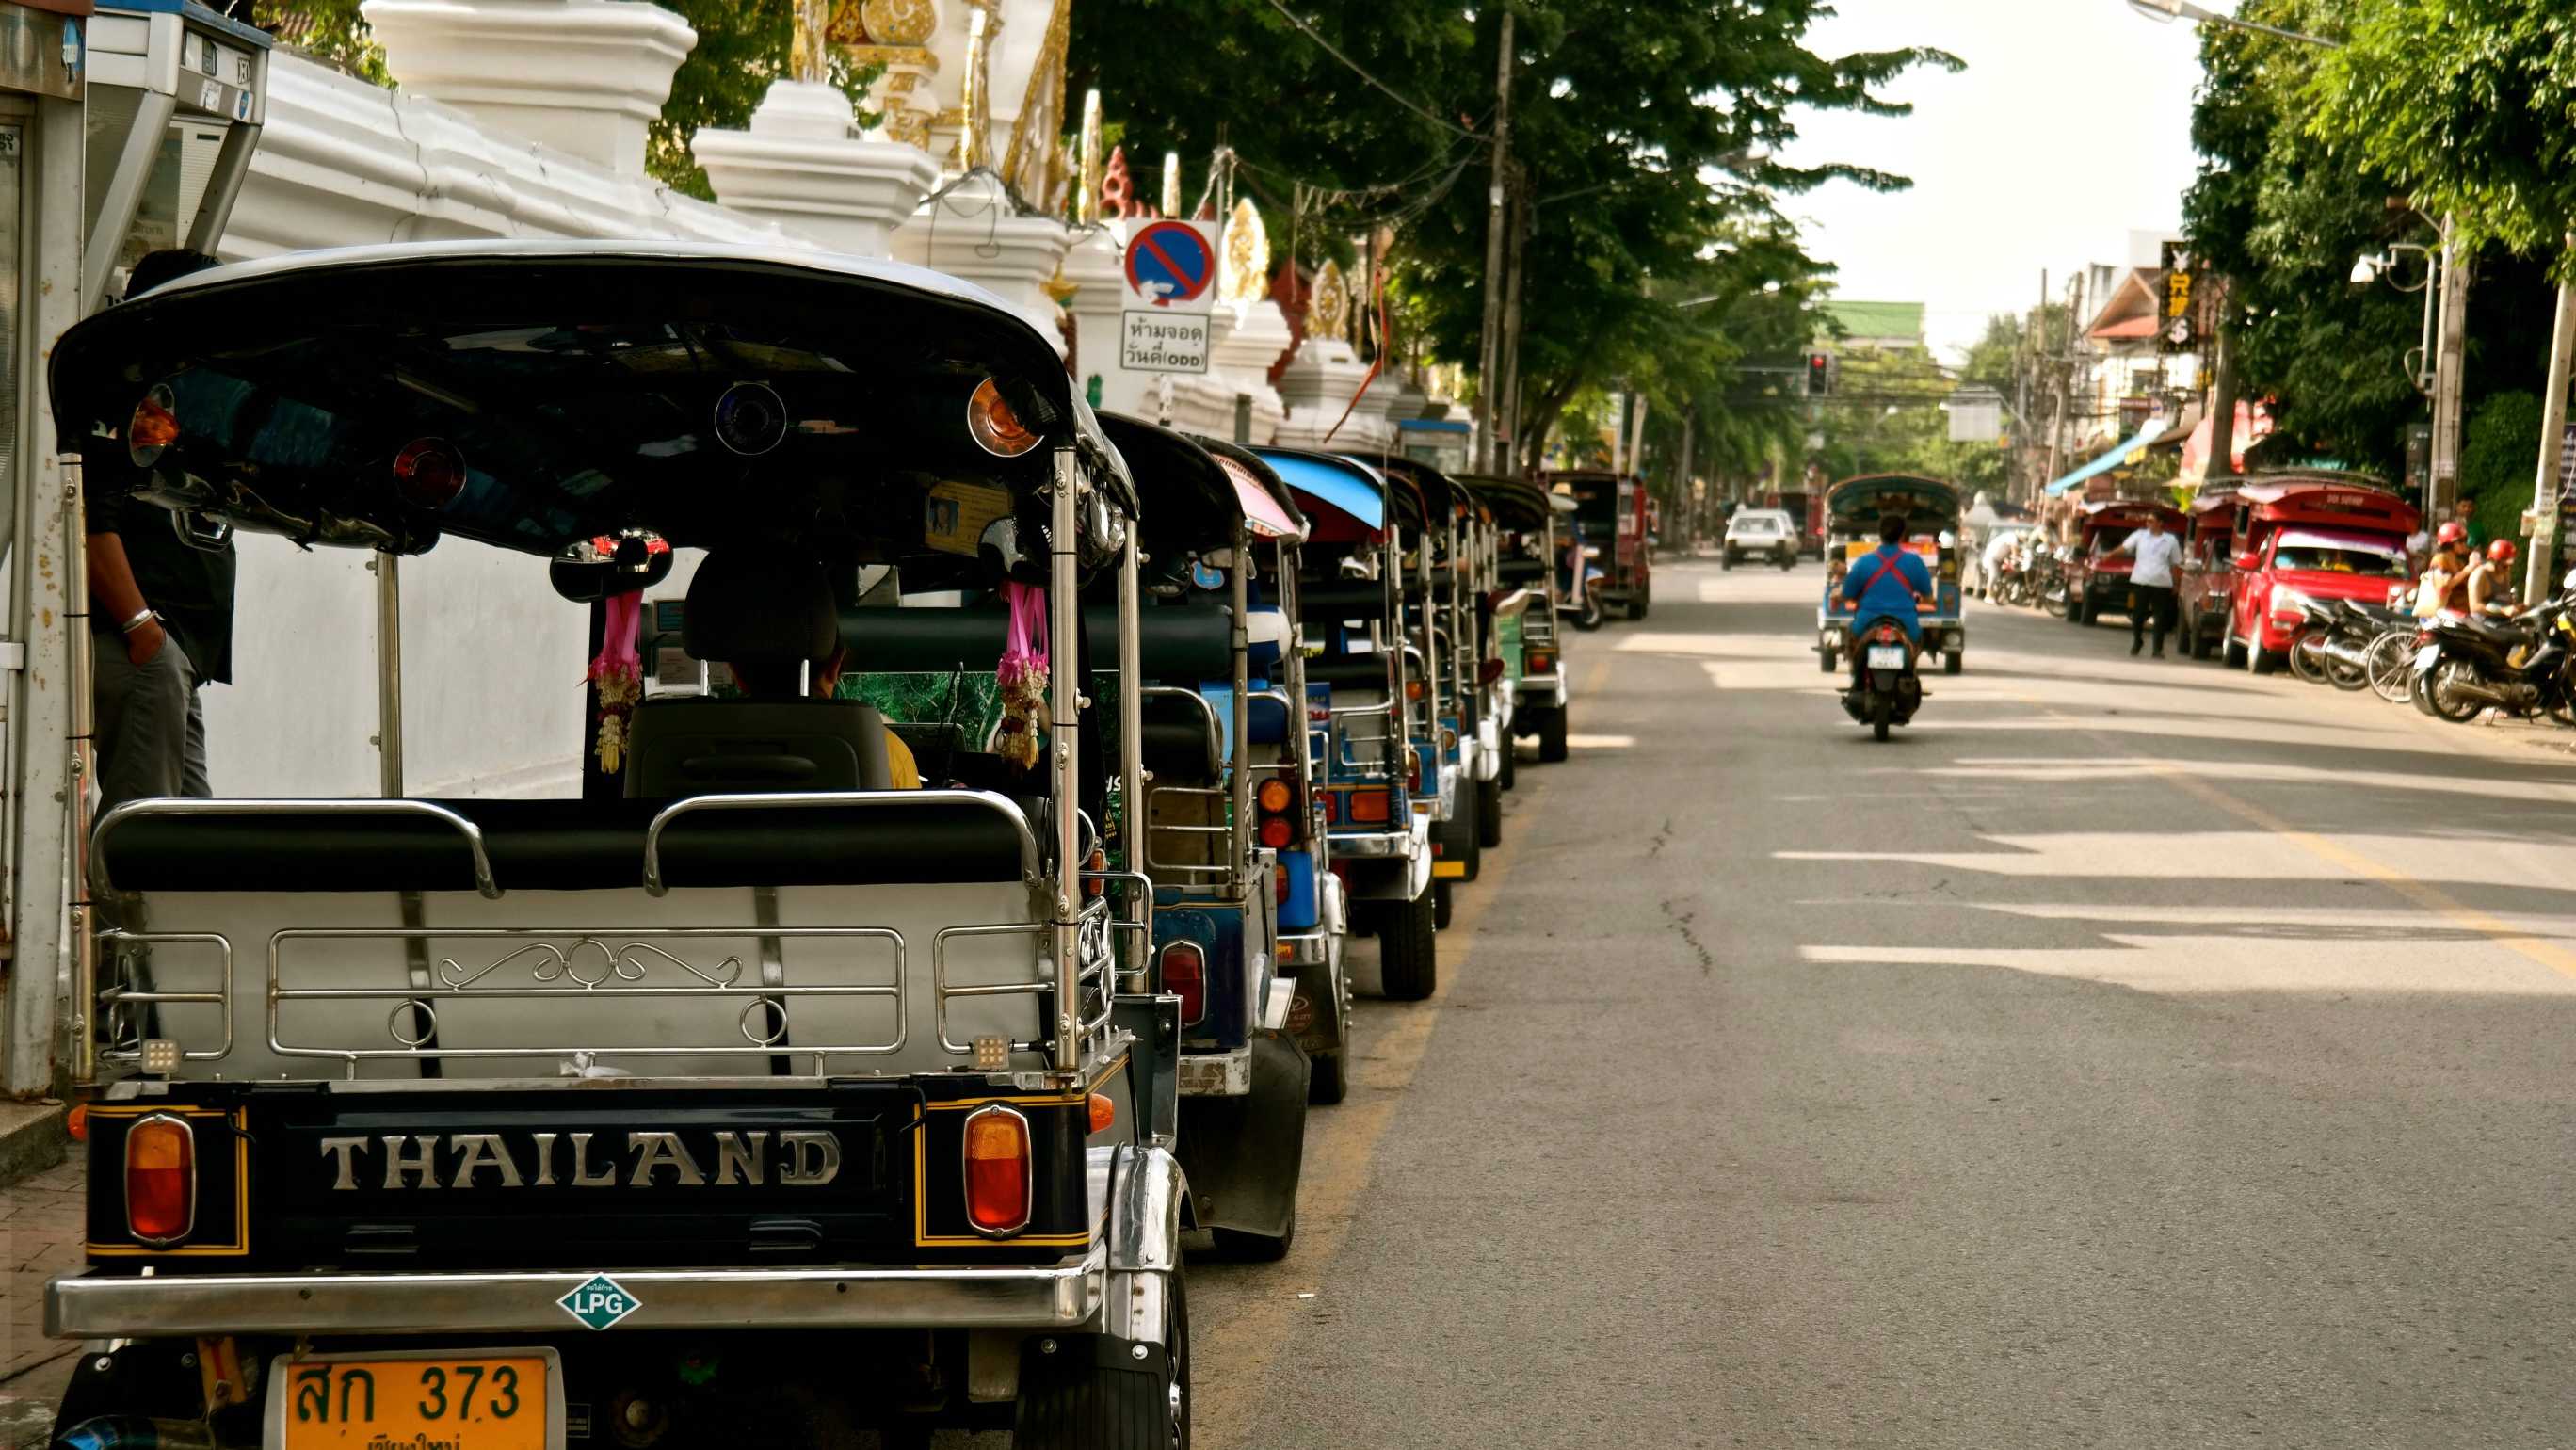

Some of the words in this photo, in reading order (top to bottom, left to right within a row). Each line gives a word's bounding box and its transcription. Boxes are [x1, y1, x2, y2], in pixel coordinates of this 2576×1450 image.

[320, 1132, 842, 1190] THAILAND
[574, 1293, 623, 1314] LPG
[296, 1364, 375, 1423] สก
[418, 1365, 520, 1421] 373
